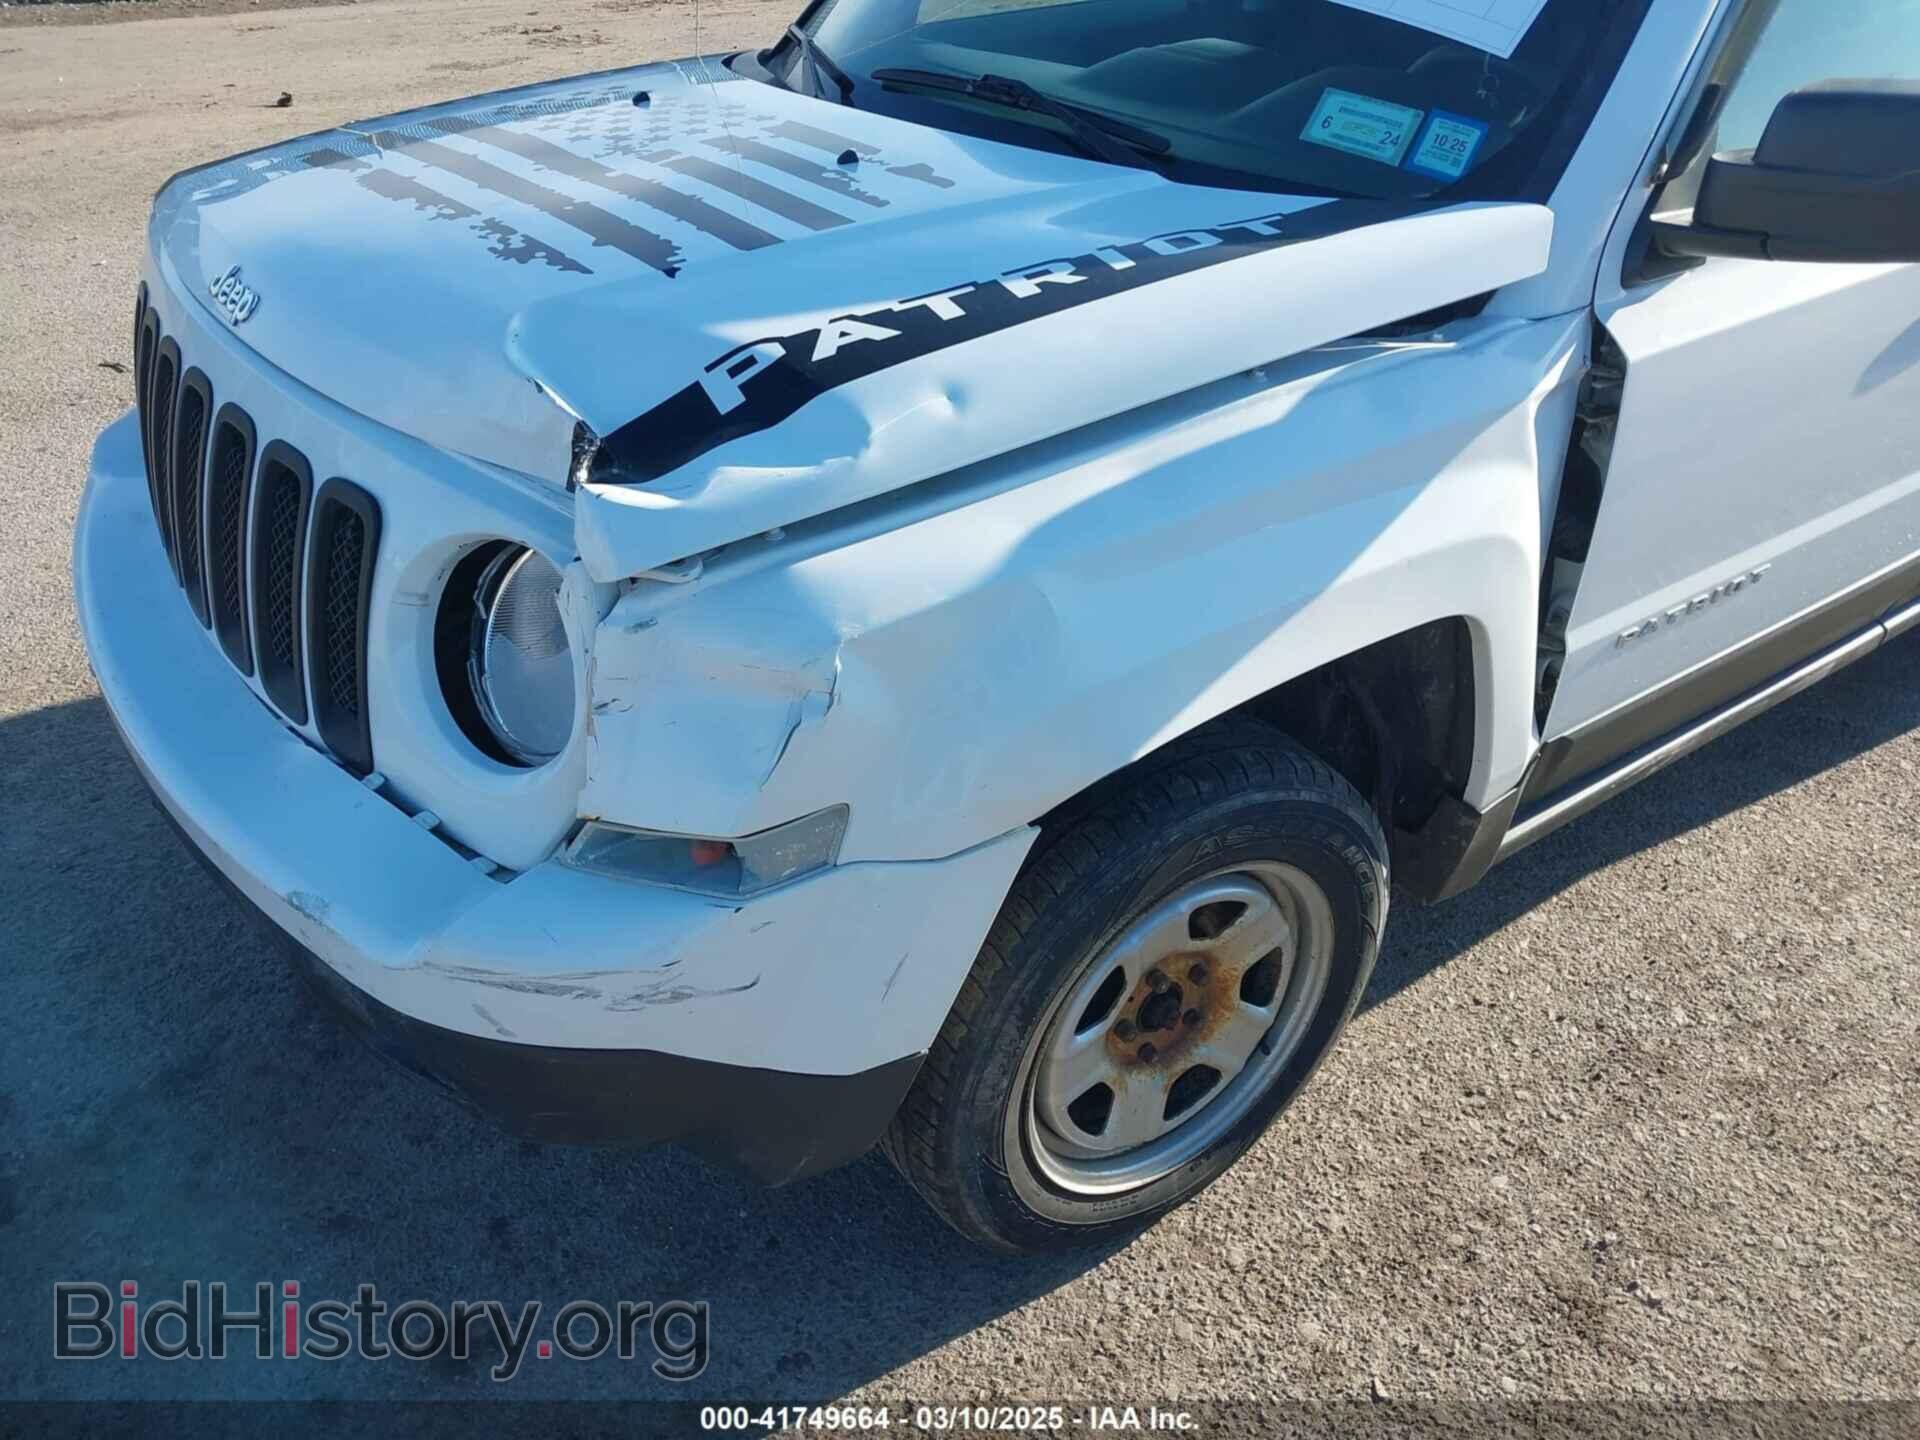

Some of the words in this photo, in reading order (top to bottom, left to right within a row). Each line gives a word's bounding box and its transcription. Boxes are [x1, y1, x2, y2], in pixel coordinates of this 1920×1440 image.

[1321, 115, 1334, 129] 6
[1378, 130, 1401, 147] 24
[1433, 133, 1449, 147] 10
[1450, 137, 1467, 153] 25
[208, 264, 261, 327] Jeep
[700, 214, 1284, 416] PATRIOT
